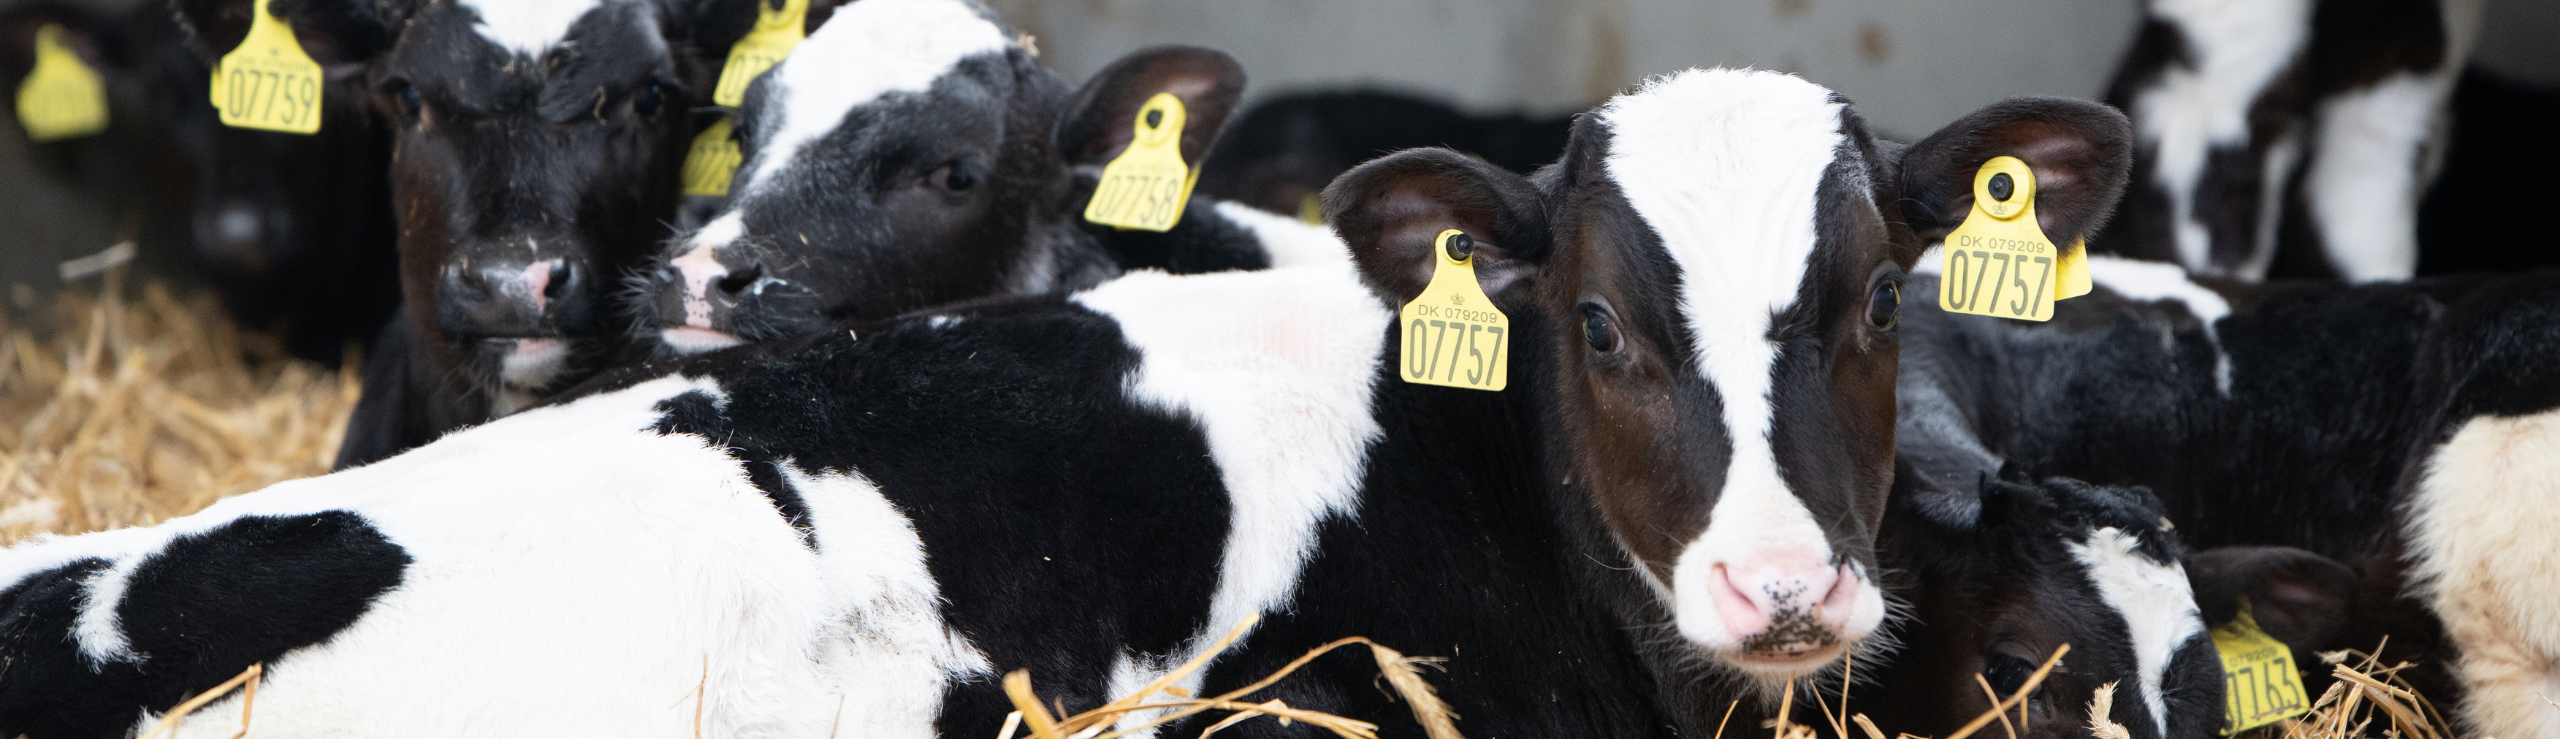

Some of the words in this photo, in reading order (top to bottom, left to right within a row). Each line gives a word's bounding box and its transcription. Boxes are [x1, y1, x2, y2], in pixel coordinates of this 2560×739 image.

[229, 68, 316, 127] 07759
[1094, 174, 1179, 226] 07758
[1960, 235, 1983, 248] DK
[1988, 237, 2045, 253] 079209
[1948, 249, 2052, 318] 07757
[1418, 304, 1440, 317] DK
[1445, 307, 1498, 323] 079209
[1409, 318, 1504, 387] 07757
[2222, 657, 2301, 731] 7763
